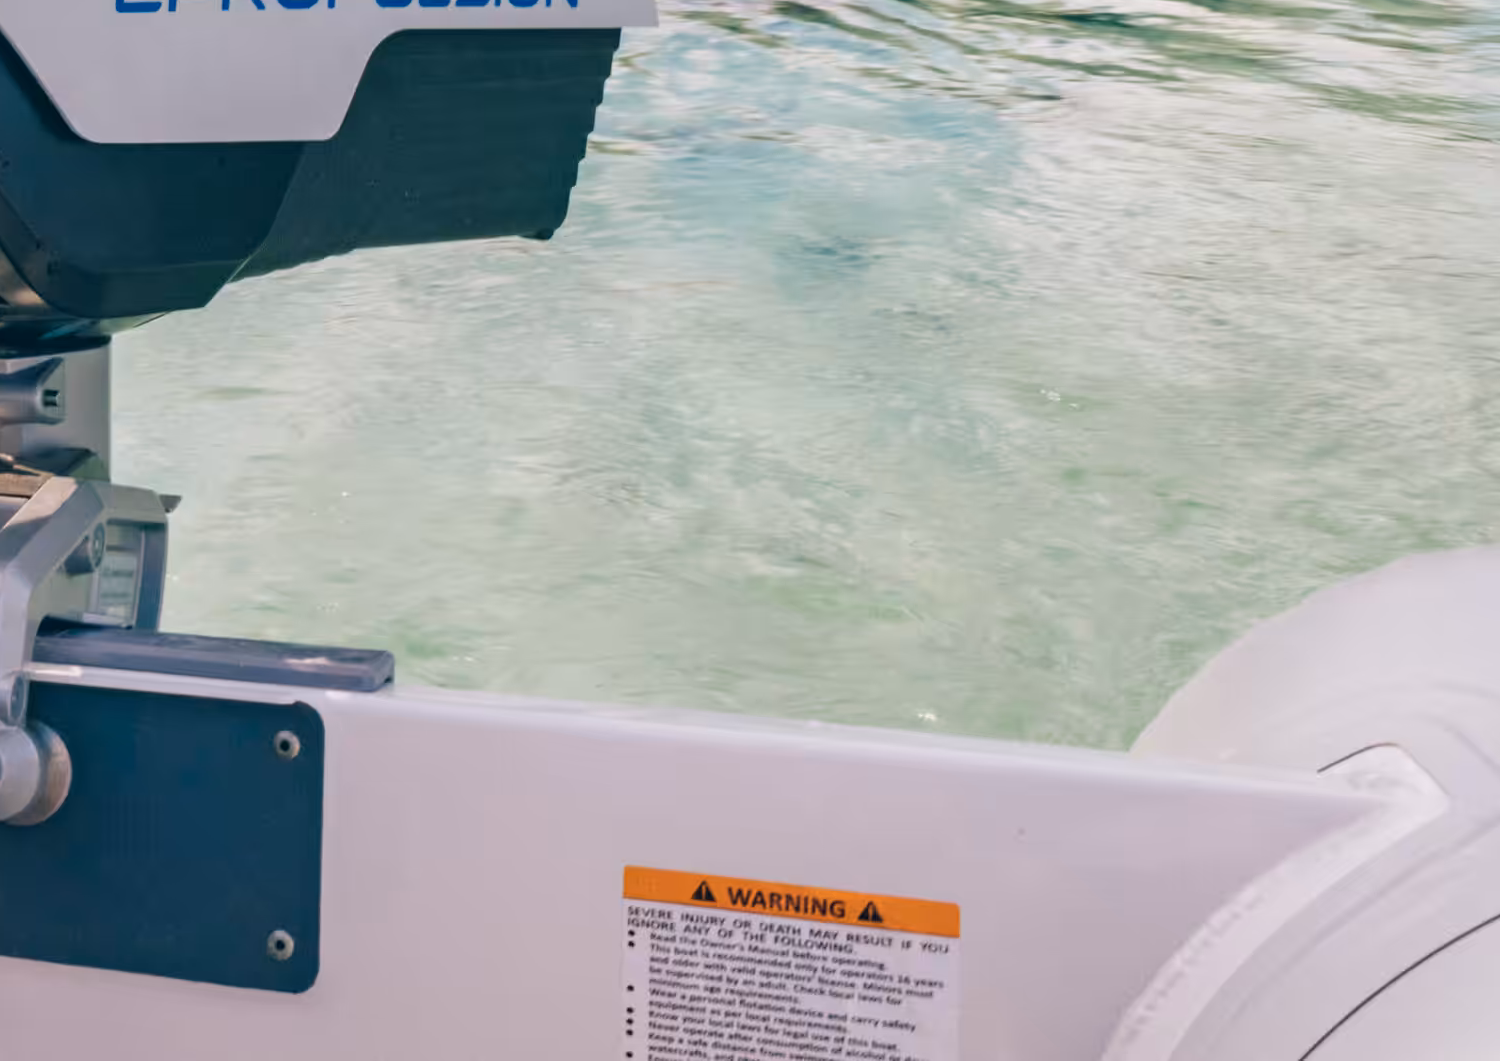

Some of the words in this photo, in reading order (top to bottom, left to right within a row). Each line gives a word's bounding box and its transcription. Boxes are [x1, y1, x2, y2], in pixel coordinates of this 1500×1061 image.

[727, 887, 847, 919] WARNING
[627, 905, 672, 920] SEVERE
[680, 912, 725, 926] INJURY
[733, 918, 750, 929] OR
[759, 921, 800, 935] DEATH
[809, 928, 838, 940] MAY
[846, 932, 893, 947] RESULT
[901, 939, 912, 949] IF
[919, 941, 949, 953] YOU
[627, 917, 675, 931] IGNORE
[683, 923, 709, 935] ANY
[717, 927, 733, 938] OF
[742, 930, 765, 942] THE
[650, 933, 675, 942] Read
[679, 936, 695, 945] the
[700, 938, 744, 951] Owner's
[747, 944, 788, 956] Manual
[792, 950, 826, 961] before
[650, 944, 670, 953] This
[674, 946, 697, 956] boat
[712, 953, 790, 968] recommended
[794, 963, 817, 973] only
[821, 965, 836, 974] for
[840, 969, 892, 982] operators
[914, 978, 943, 989] years
[650, 955, 668, 964] and
[672, 958, 699, 968] older
[703, 961, 726, 971] with
[731, 965, 755, 975] valid
[862, 982, 901, 994] Minors
[905, 987, 933, 998] must
[649, 965, 661, 973] be
[665, 969, 722, 982] supervised
[726, 976, 738, 985] by
[793, 983, 824, 995] Check
[828, 988, 853, 999] local
[857, 992, 882, 1003] laws
[886, 996, 900, 1005] for
[649, 978, 699, 989] minimum
[703, 985, 720, 994] age
[649, 1000, 706, 1013] equipment
[650, 987, 676, 998] Wear
[688, 994, 736, 1006] personal
[789, 1006, 823, 1018] device
[828, 1011, 847, 1021] and
[851, 1015, 878, 1027] carry
[882, 1018, 916, 1032] safety
[764, 1025, 779, 1034] for
[832, 1035, 844, 1044] of
[847, 1037, 868, 1047] this
